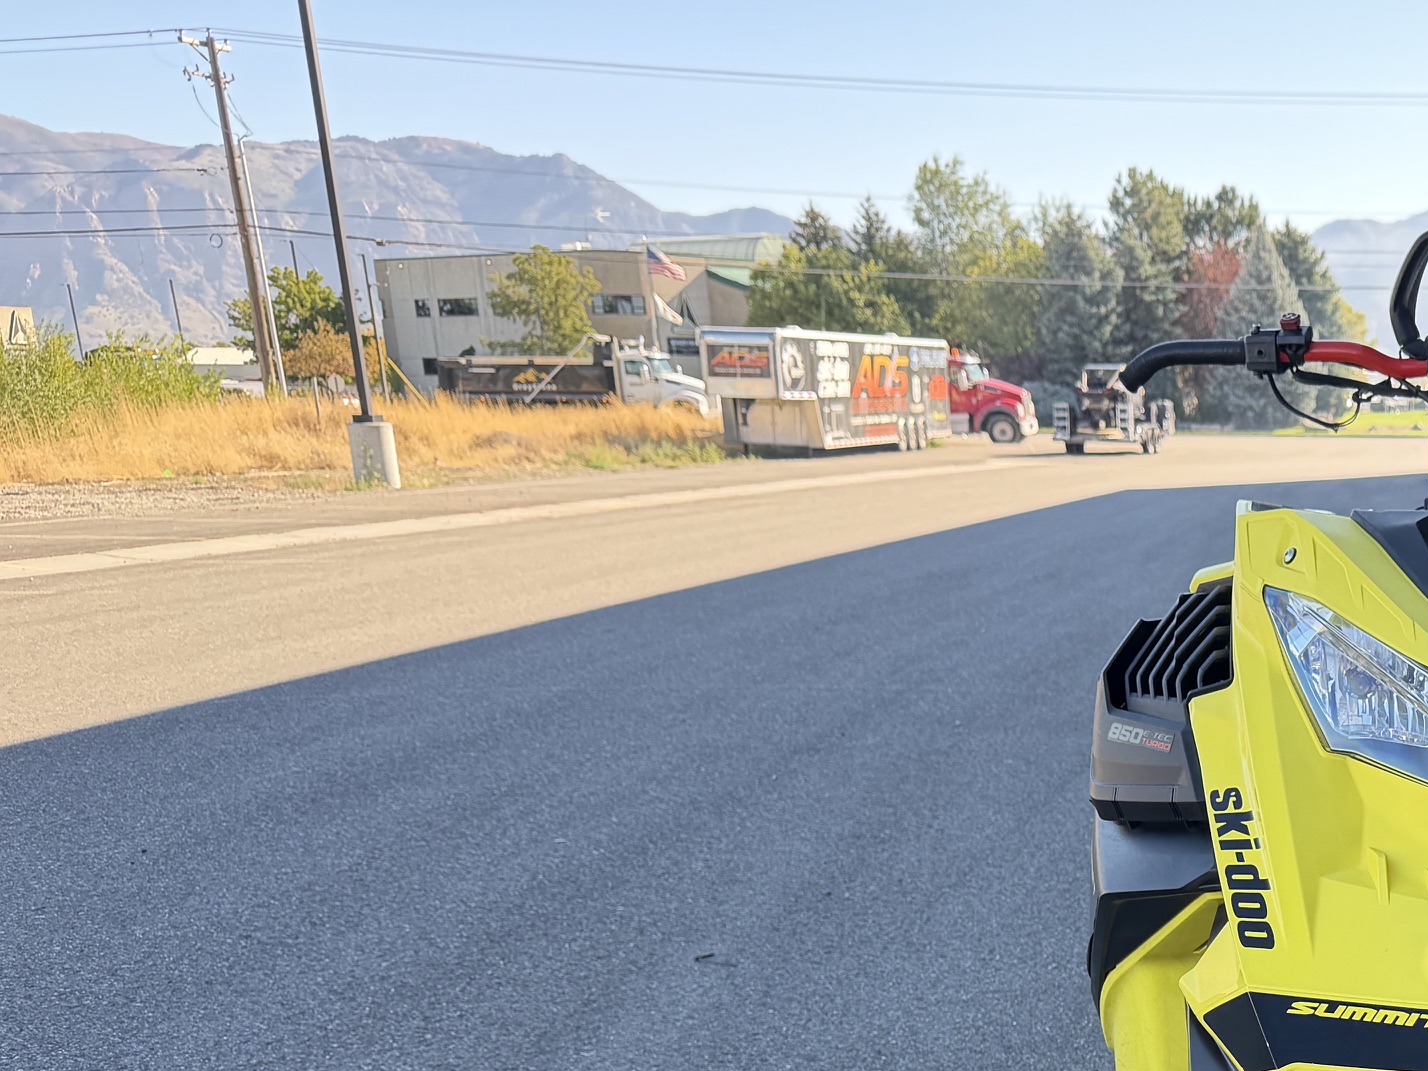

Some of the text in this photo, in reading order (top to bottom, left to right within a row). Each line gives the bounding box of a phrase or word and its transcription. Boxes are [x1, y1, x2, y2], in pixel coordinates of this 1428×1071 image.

[711, 351, 769, 367] ADS
[853, 355, 909, 398] ADS
[1107, 722, 1173, 744] 850 E-TEC
[1142, 738, 1172, 751] TURBO
[1209, 787, 1276, 950] ski-doo
